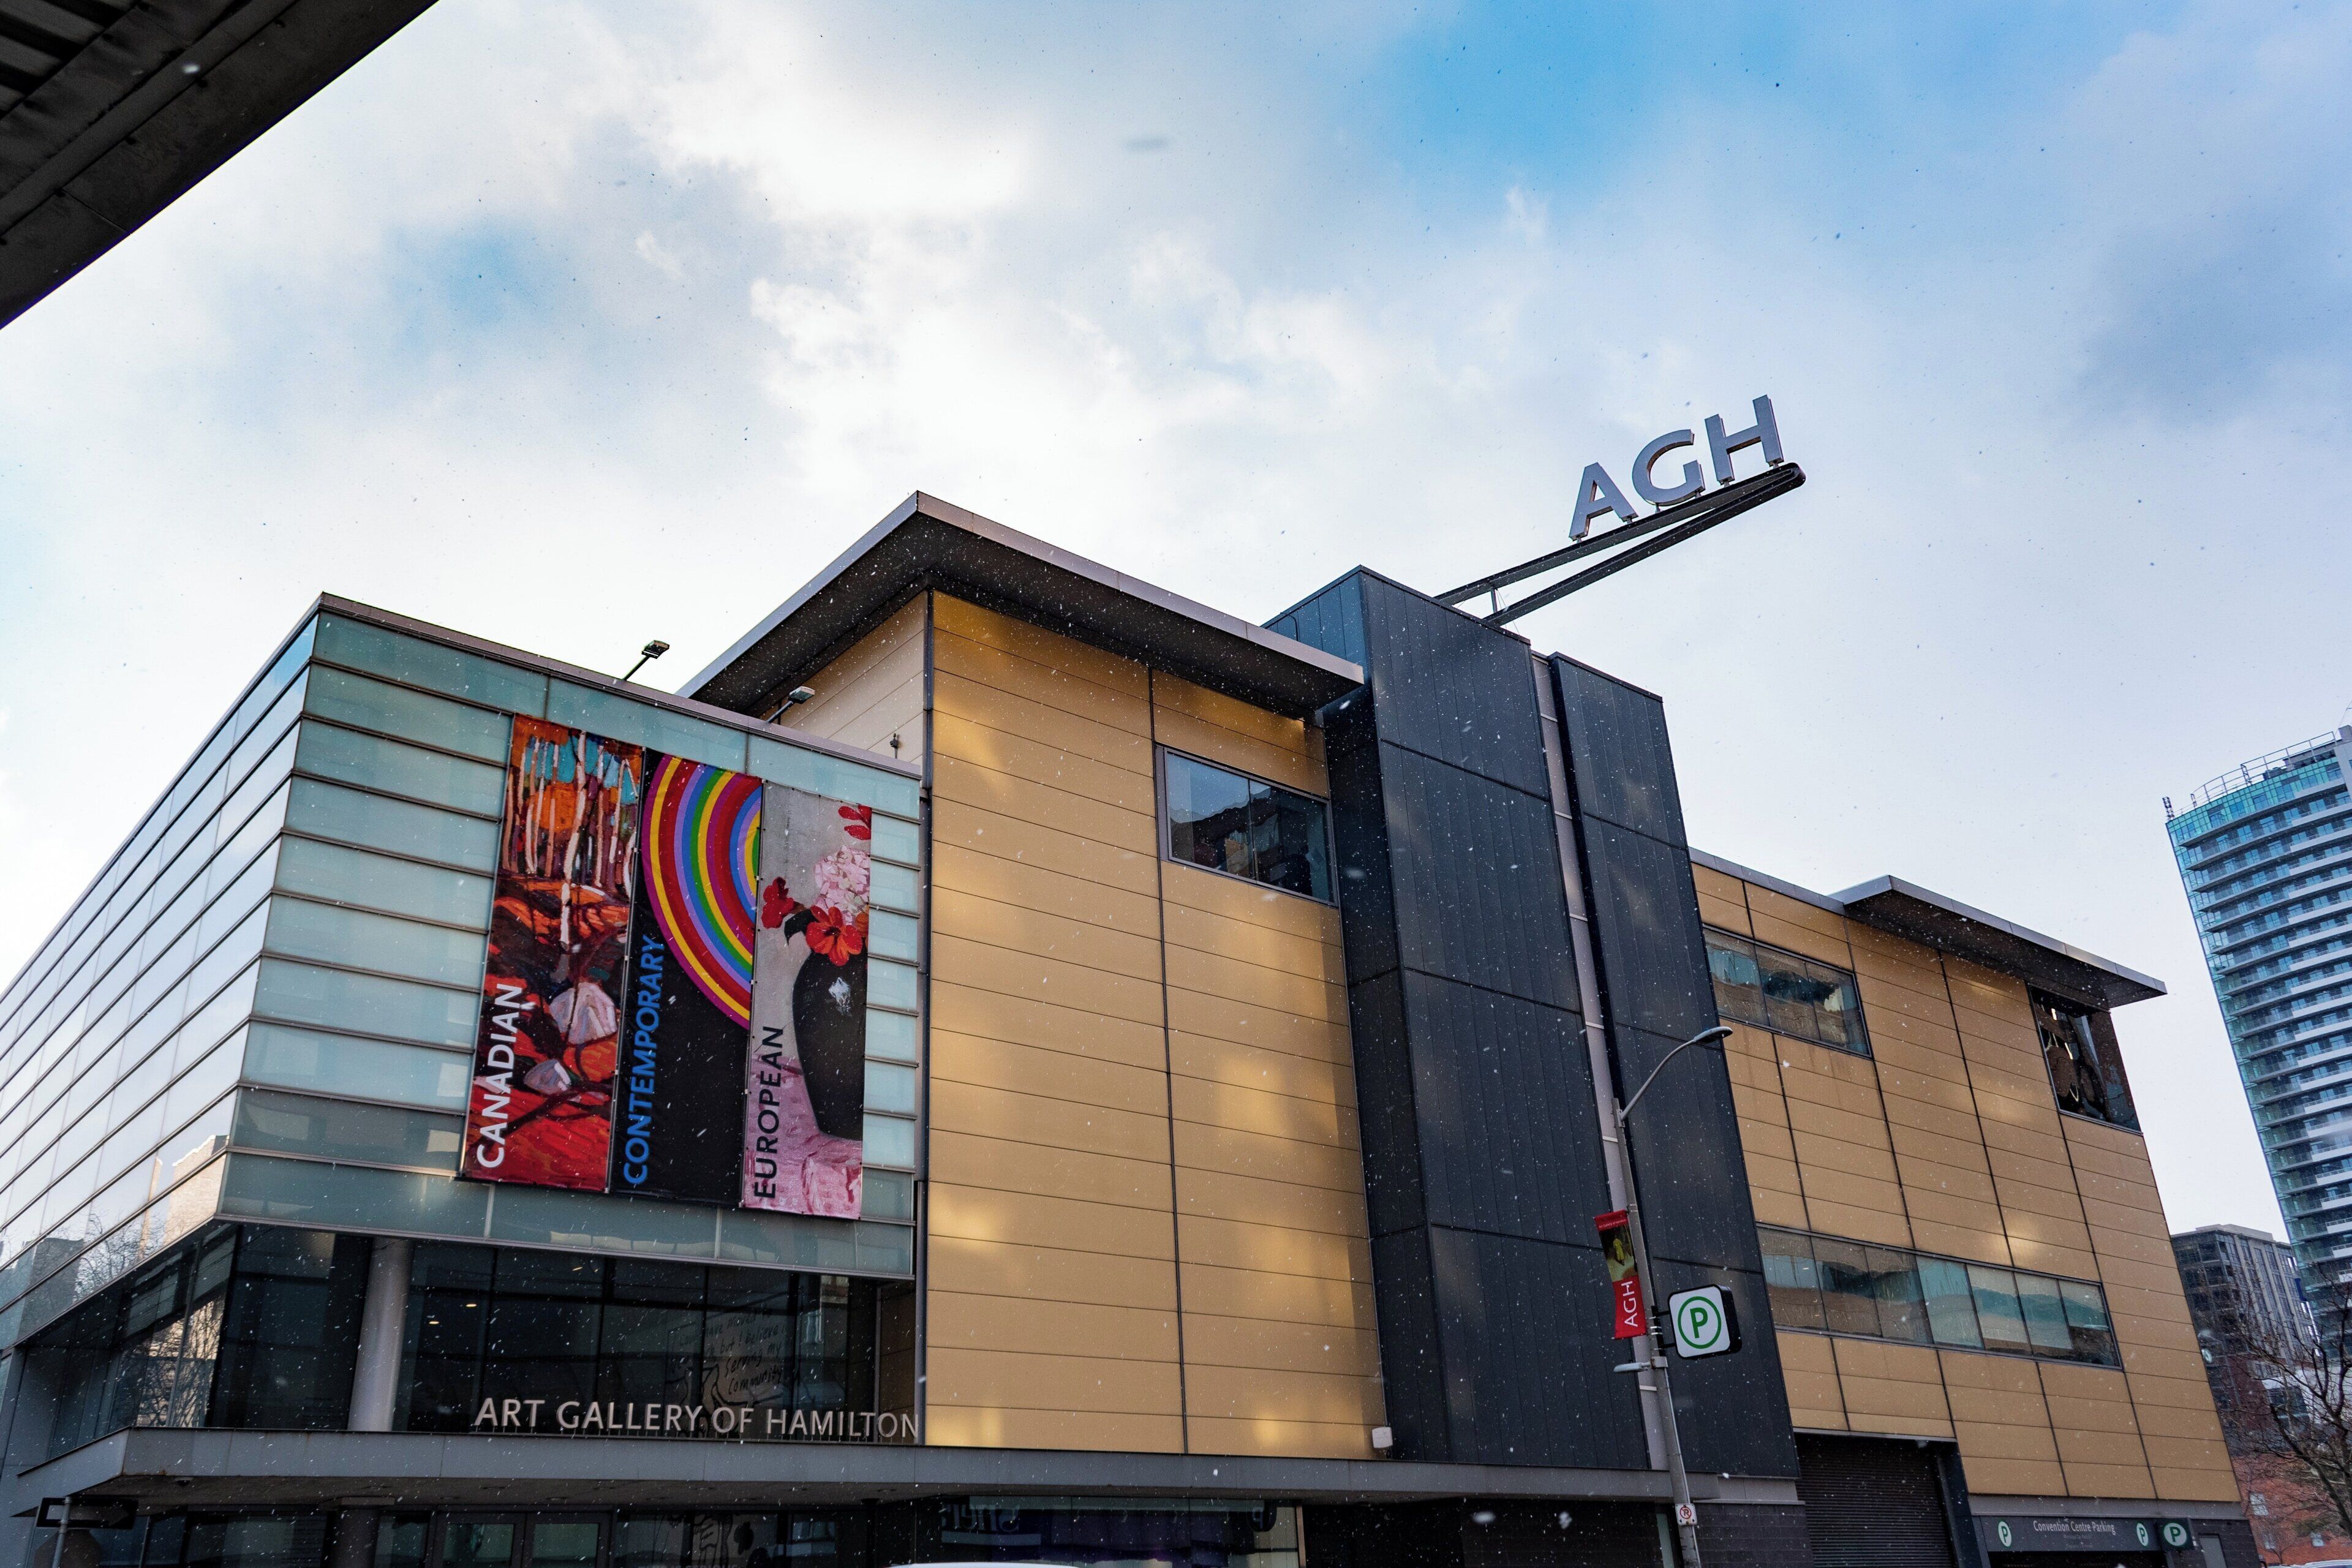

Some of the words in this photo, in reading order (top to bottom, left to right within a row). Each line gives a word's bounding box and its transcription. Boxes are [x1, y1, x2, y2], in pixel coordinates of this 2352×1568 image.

[1568, 394, 1784, 541] AGH
[477, 983, 522, 1169] CANADIAN
[623, 935, 665, 1185] CONTEMPORARY
[754, 1026, 783, 1199] EUROPEAN
[1621, 1281, 1638, 1327] AGH
[1689, 1307, 1708, 1338] P
[475, 1397, 545, 1427] ART
[556, 1401, 703, 1431] GALLERY
[712, 1408, 754, 1433] OF
[766, 1409, 919, 1438] HAMILTON
[2033, 1520, 2069, 1532] Convention
[2070, 1521, 2091, 1532] Centre
[2092, 1521, 2116, 1536] Parking
[2170, 1526, 2180, 1542] P
